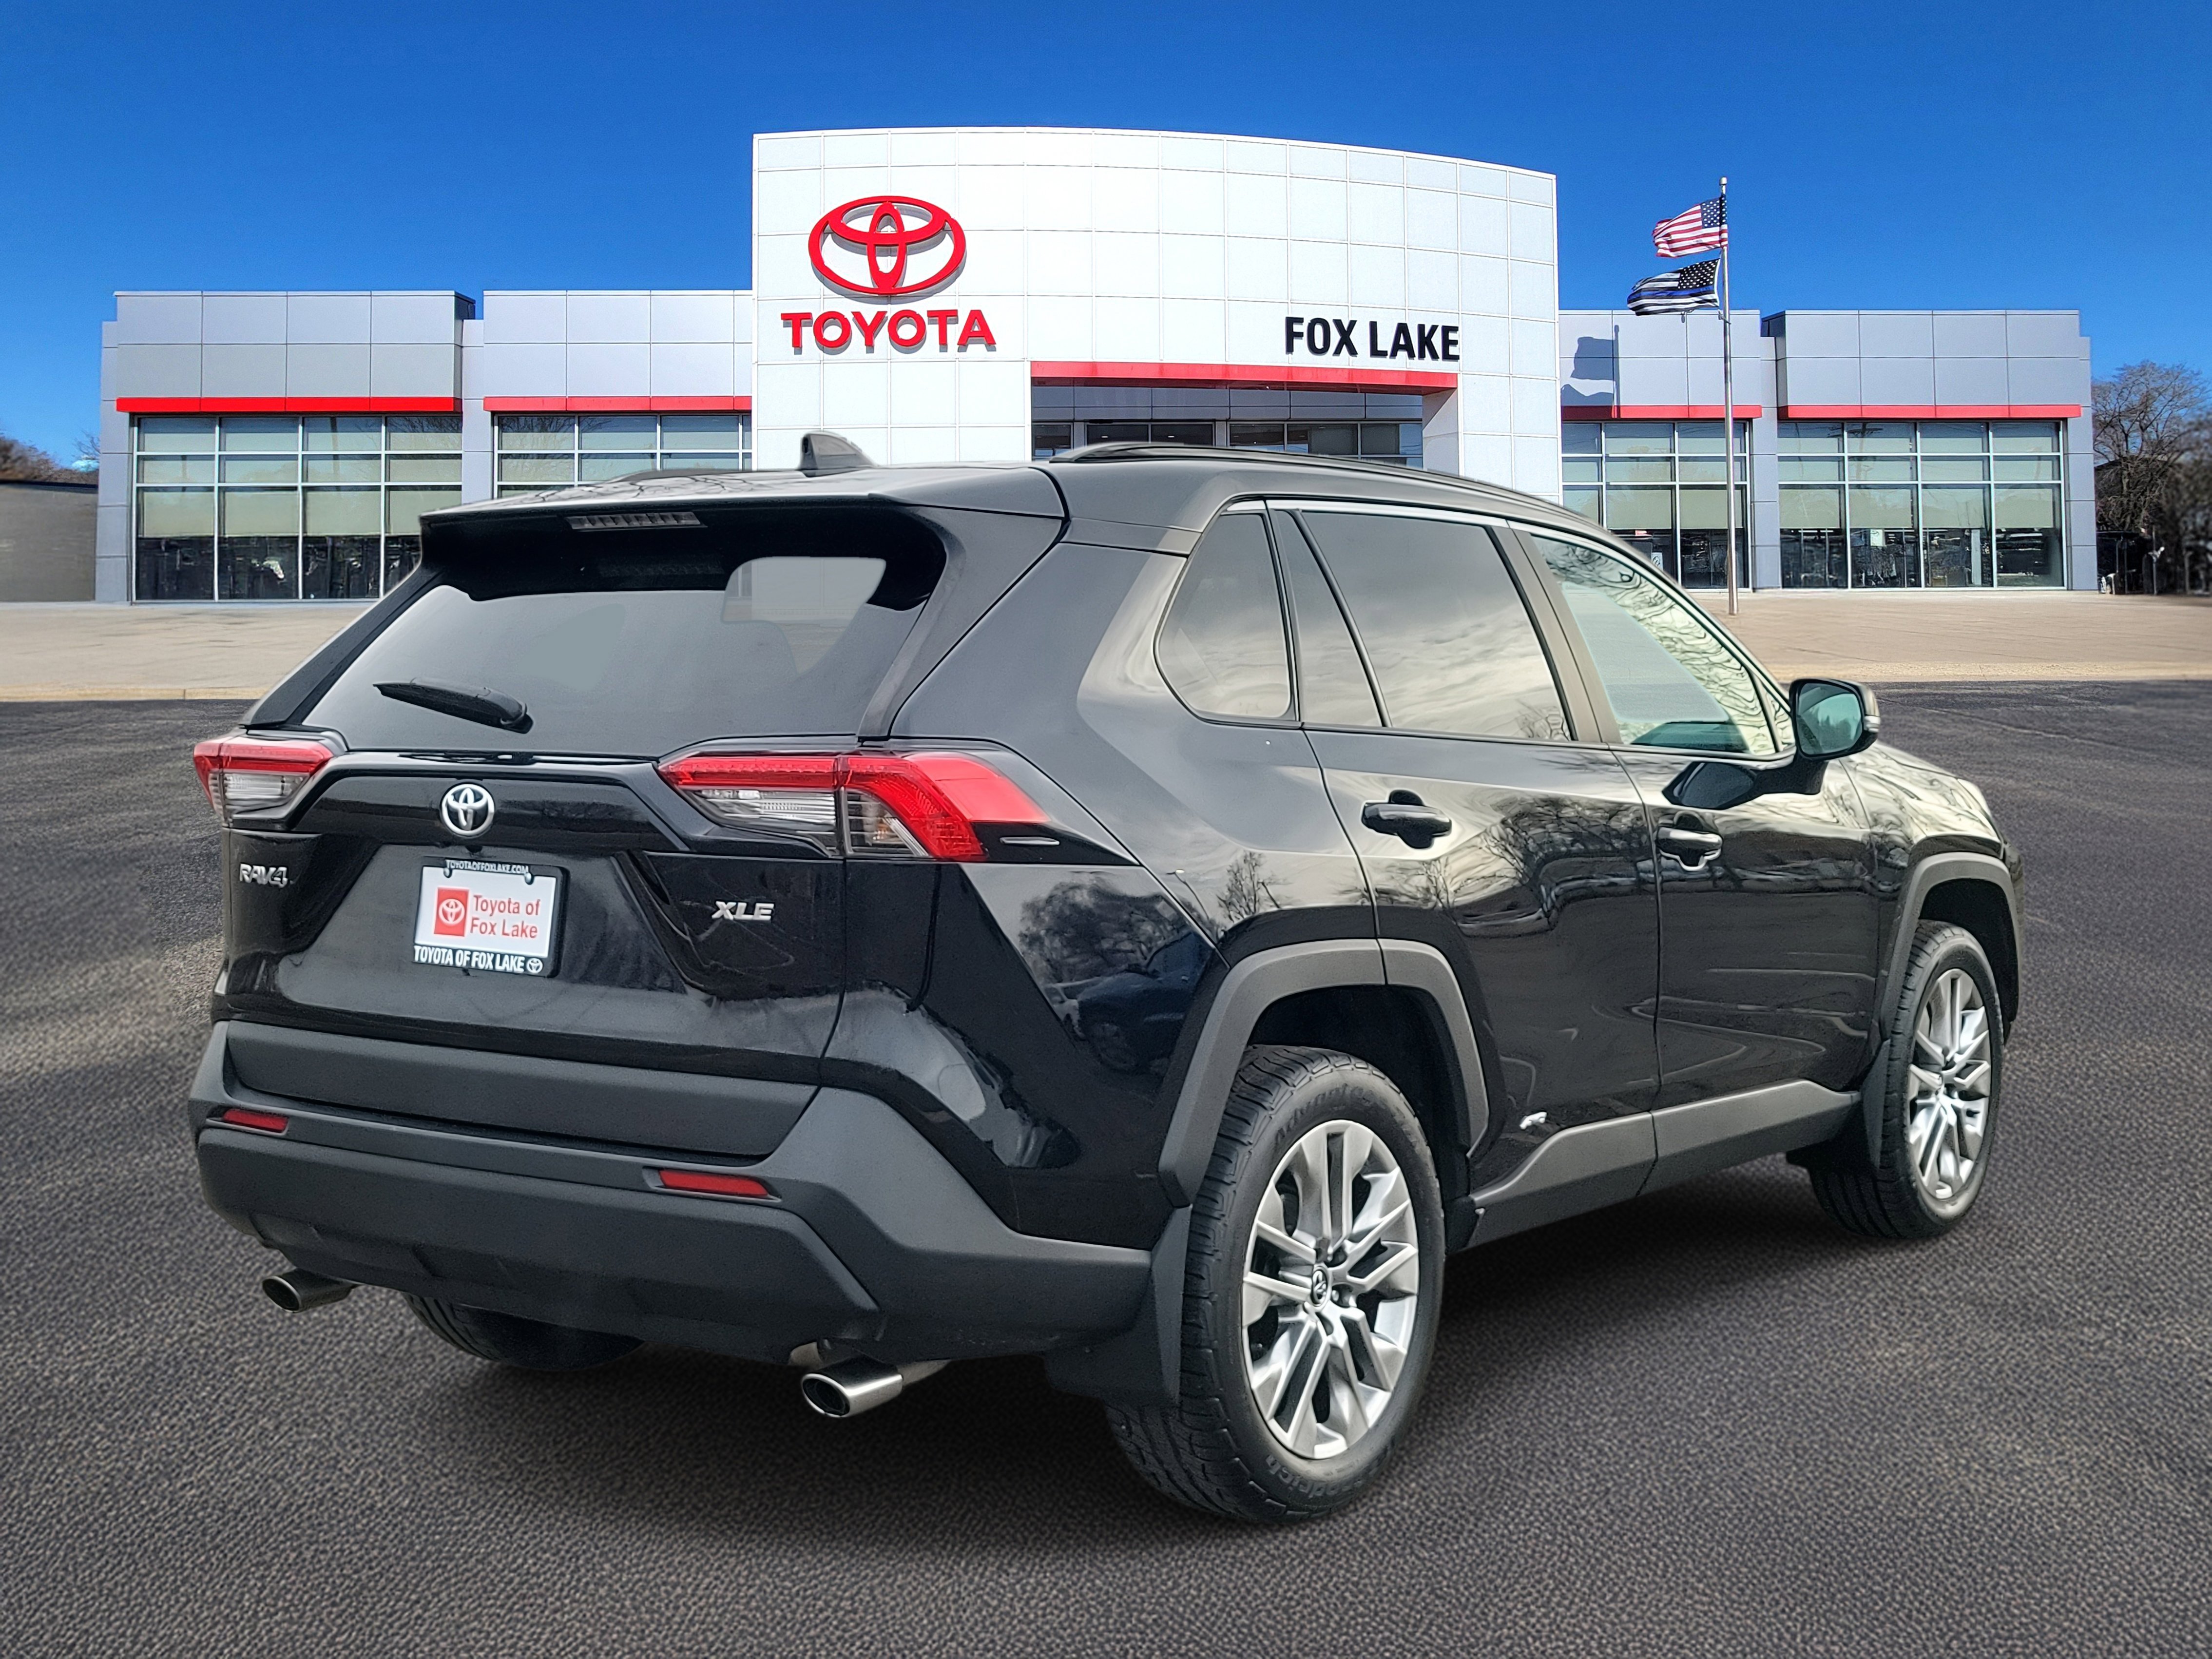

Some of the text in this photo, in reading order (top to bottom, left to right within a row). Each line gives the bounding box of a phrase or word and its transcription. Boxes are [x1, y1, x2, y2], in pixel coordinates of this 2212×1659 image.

[781, 309, 997, 348] TOYOTA
[1285, 316, 1460, 361] FOX LAKE
[239, 863, 288, 888] RAV4
[473, 894, 541, 917] Toyota of
[712, 901, 774, 921] XLE
[470, 917, 538, 939] Fox Lake
[414, 945, 525, 973] TOYOTA OF FOX LAKE
